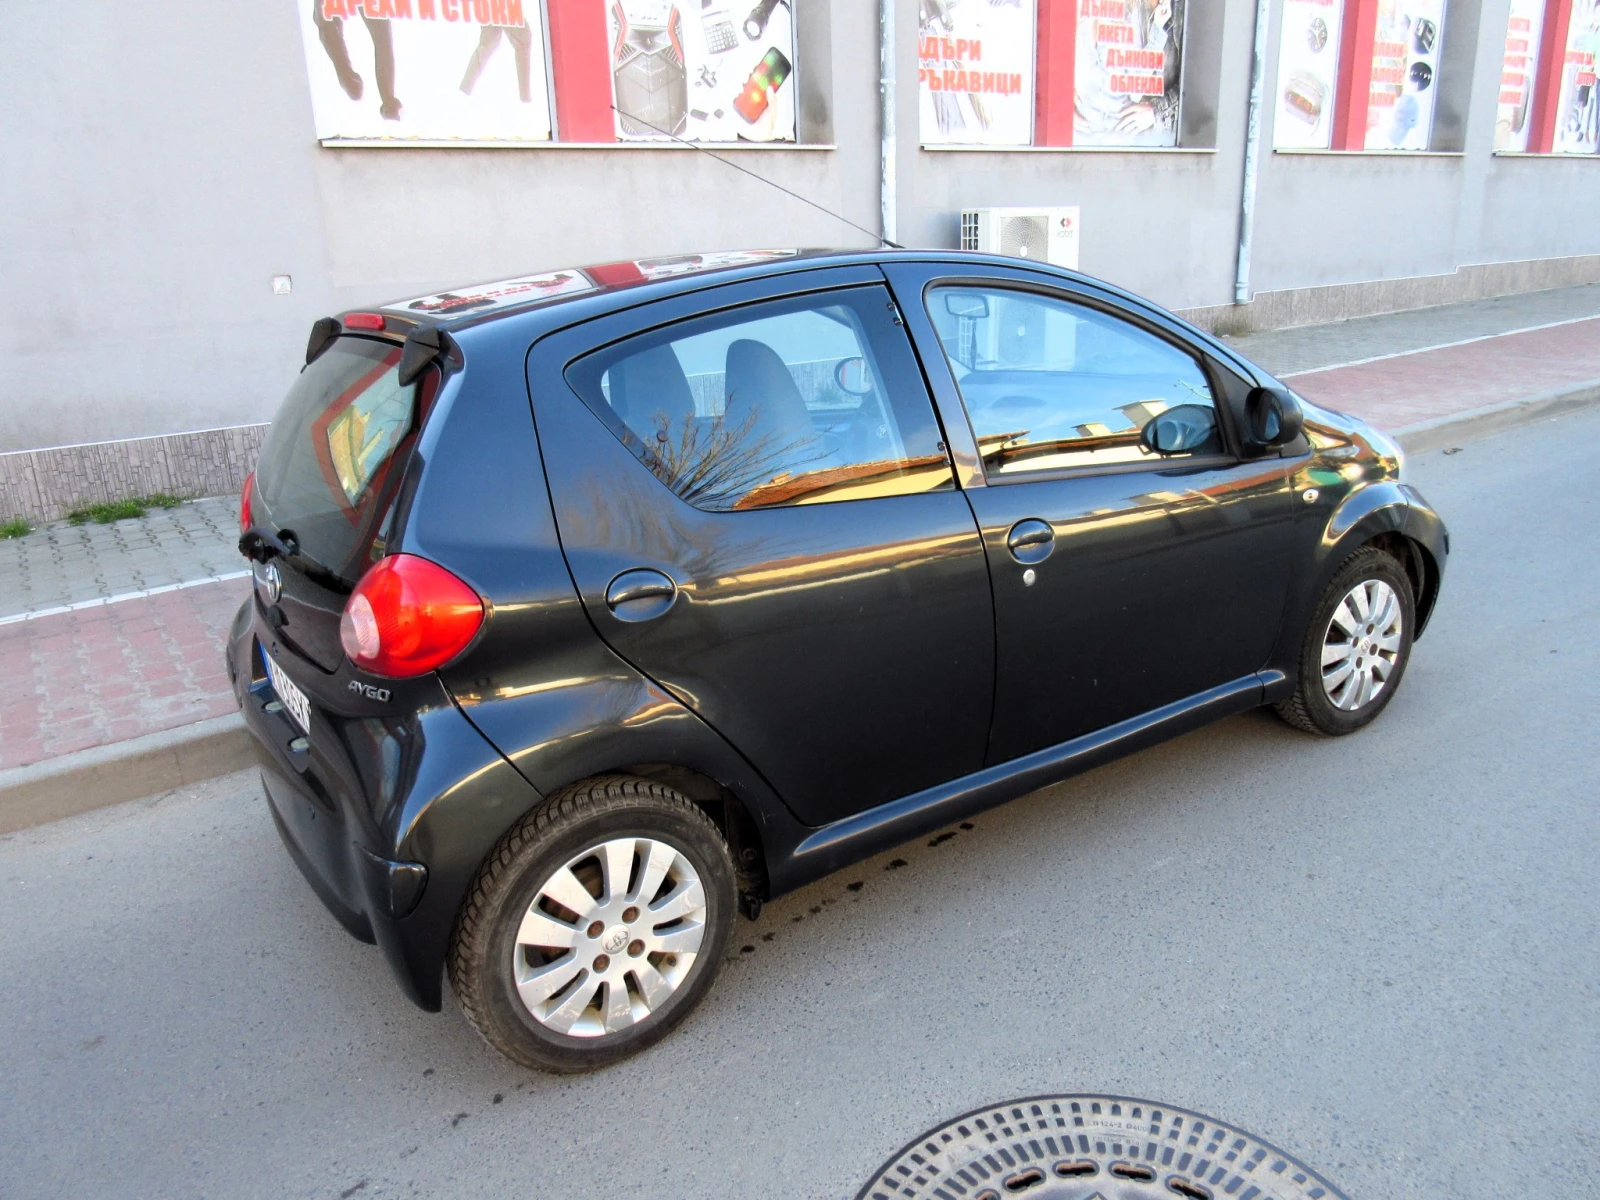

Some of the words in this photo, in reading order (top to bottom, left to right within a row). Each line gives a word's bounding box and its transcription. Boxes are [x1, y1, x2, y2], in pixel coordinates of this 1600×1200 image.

[1097, 24, 1134, 44] ЯКЕТА
[1105, 48, 1164, 70] ДЪНКОВИ
[1110, 74, 1164, 95] ОБЛЕКЛА
[348, 680, 391, 702] AYGO
